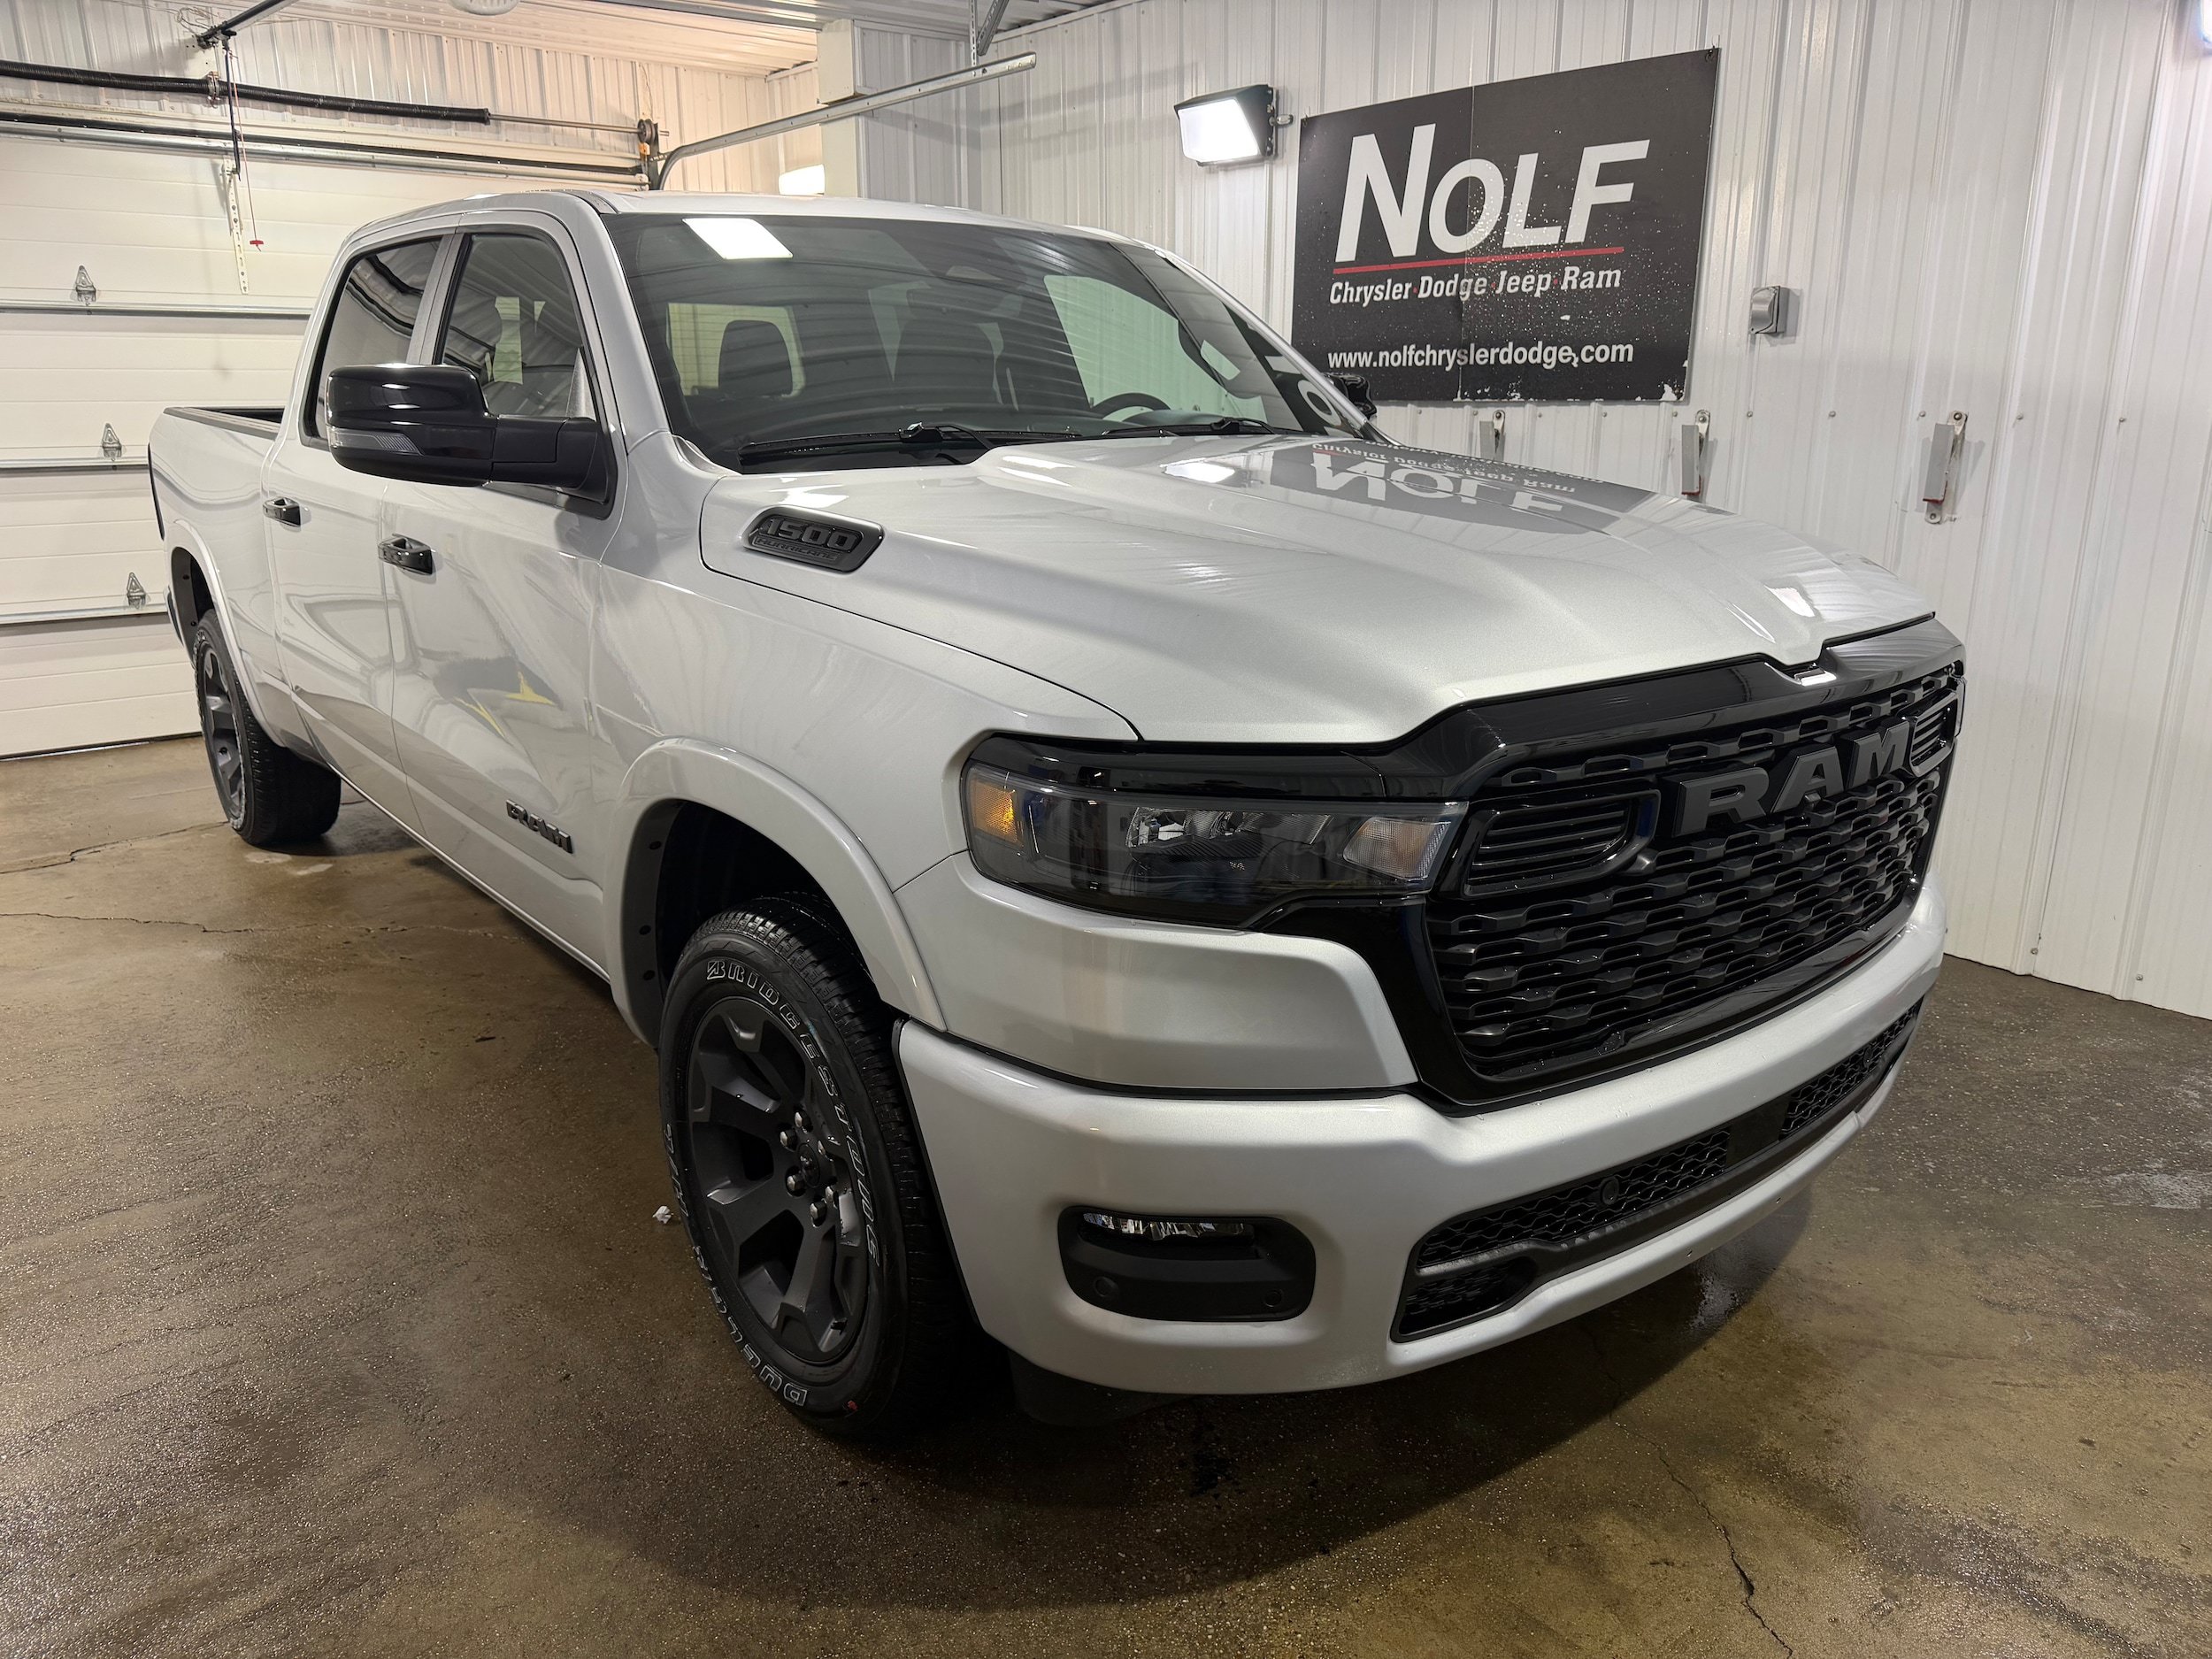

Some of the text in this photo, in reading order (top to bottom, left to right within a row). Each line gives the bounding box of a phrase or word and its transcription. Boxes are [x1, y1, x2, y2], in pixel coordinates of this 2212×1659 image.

[1335, 123, 1650, 262] NOLF
[1330, 266, 1621, 307] Chrysler Dodge Jeep Ram
[1328, 341, 1634, 372] www.nolfchryslerdodge.com
[767, 518, 857, 552] 1500
[1674, 718, 1909, 838] RAM
[506, 799, 573, 854] RAM
[707, 959, 880, 1268] BRIDGESTONE
